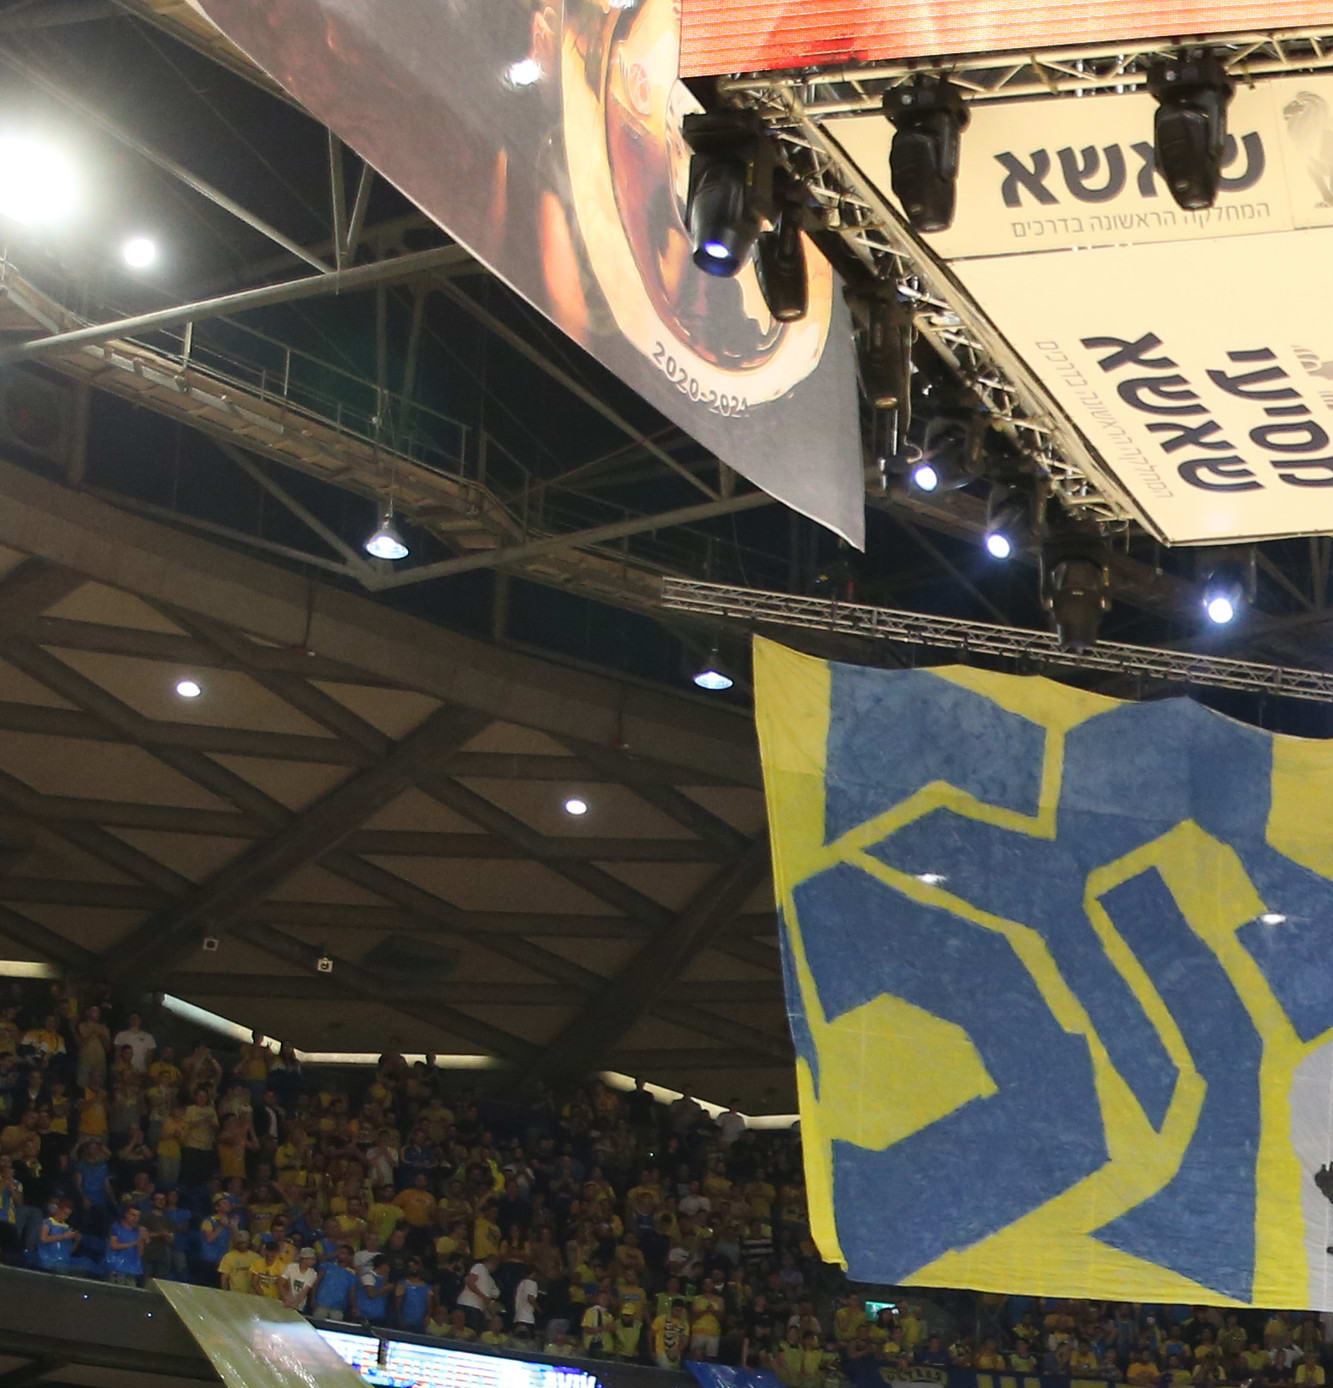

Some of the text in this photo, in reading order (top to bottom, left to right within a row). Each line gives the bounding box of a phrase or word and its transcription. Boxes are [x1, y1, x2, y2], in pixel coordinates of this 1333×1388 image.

[1011, 218, 1084, 238] בדרכים
[1090, 210, 1176, 232] הראשונה
[1079, 331, 1266, 492] שאשא
